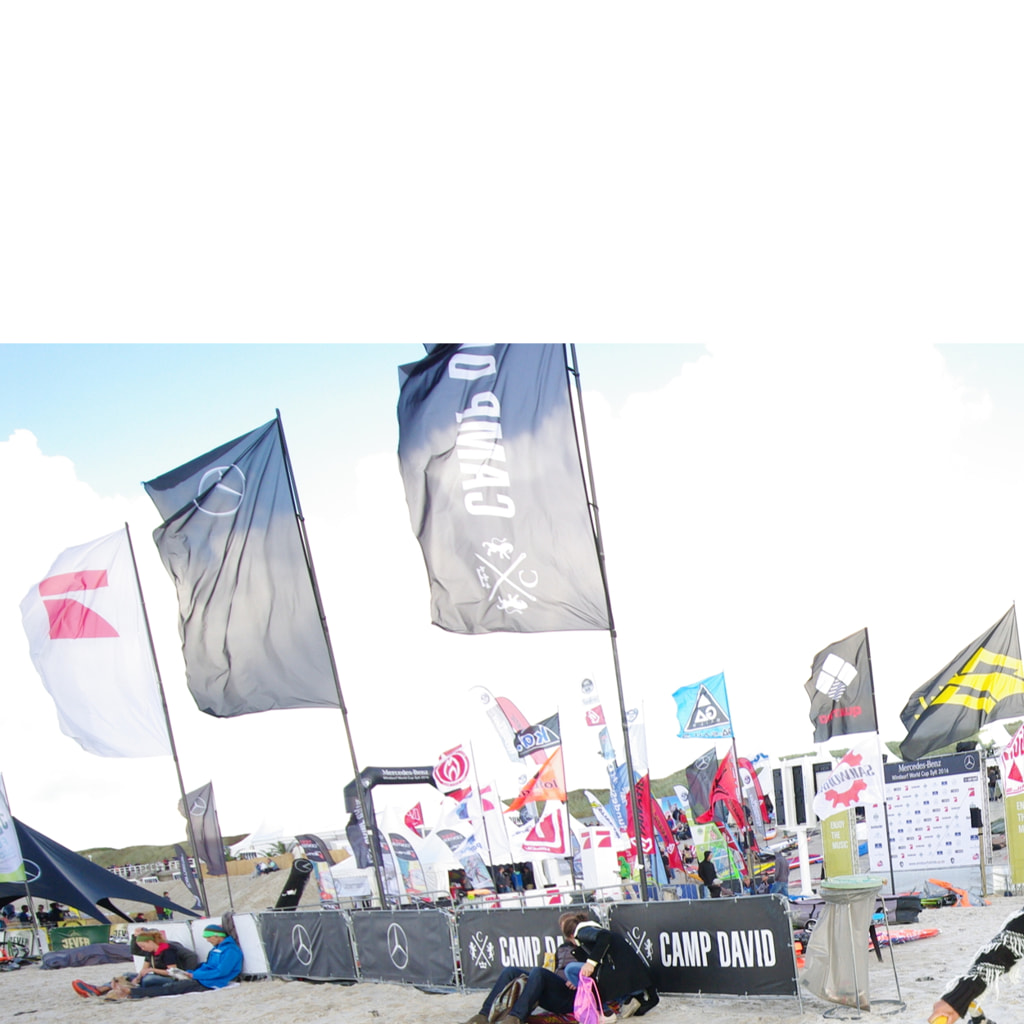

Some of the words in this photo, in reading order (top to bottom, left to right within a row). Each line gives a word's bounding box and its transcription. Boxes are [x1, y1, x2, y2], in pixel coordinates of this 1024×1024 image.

[455, 391, 516, 518] CAMP
[898, 760, 941, 773] Mercedes-Benz
[831, 830, 840, 839] THE
[832, 840, 848, 849] MUSIC
[61, 937, 90, 949] JEVER
[660, 930, 712, 967] CAMP
[717, 929, 777, 968] DAVID
[499, 936, 541, 967] CAMP
